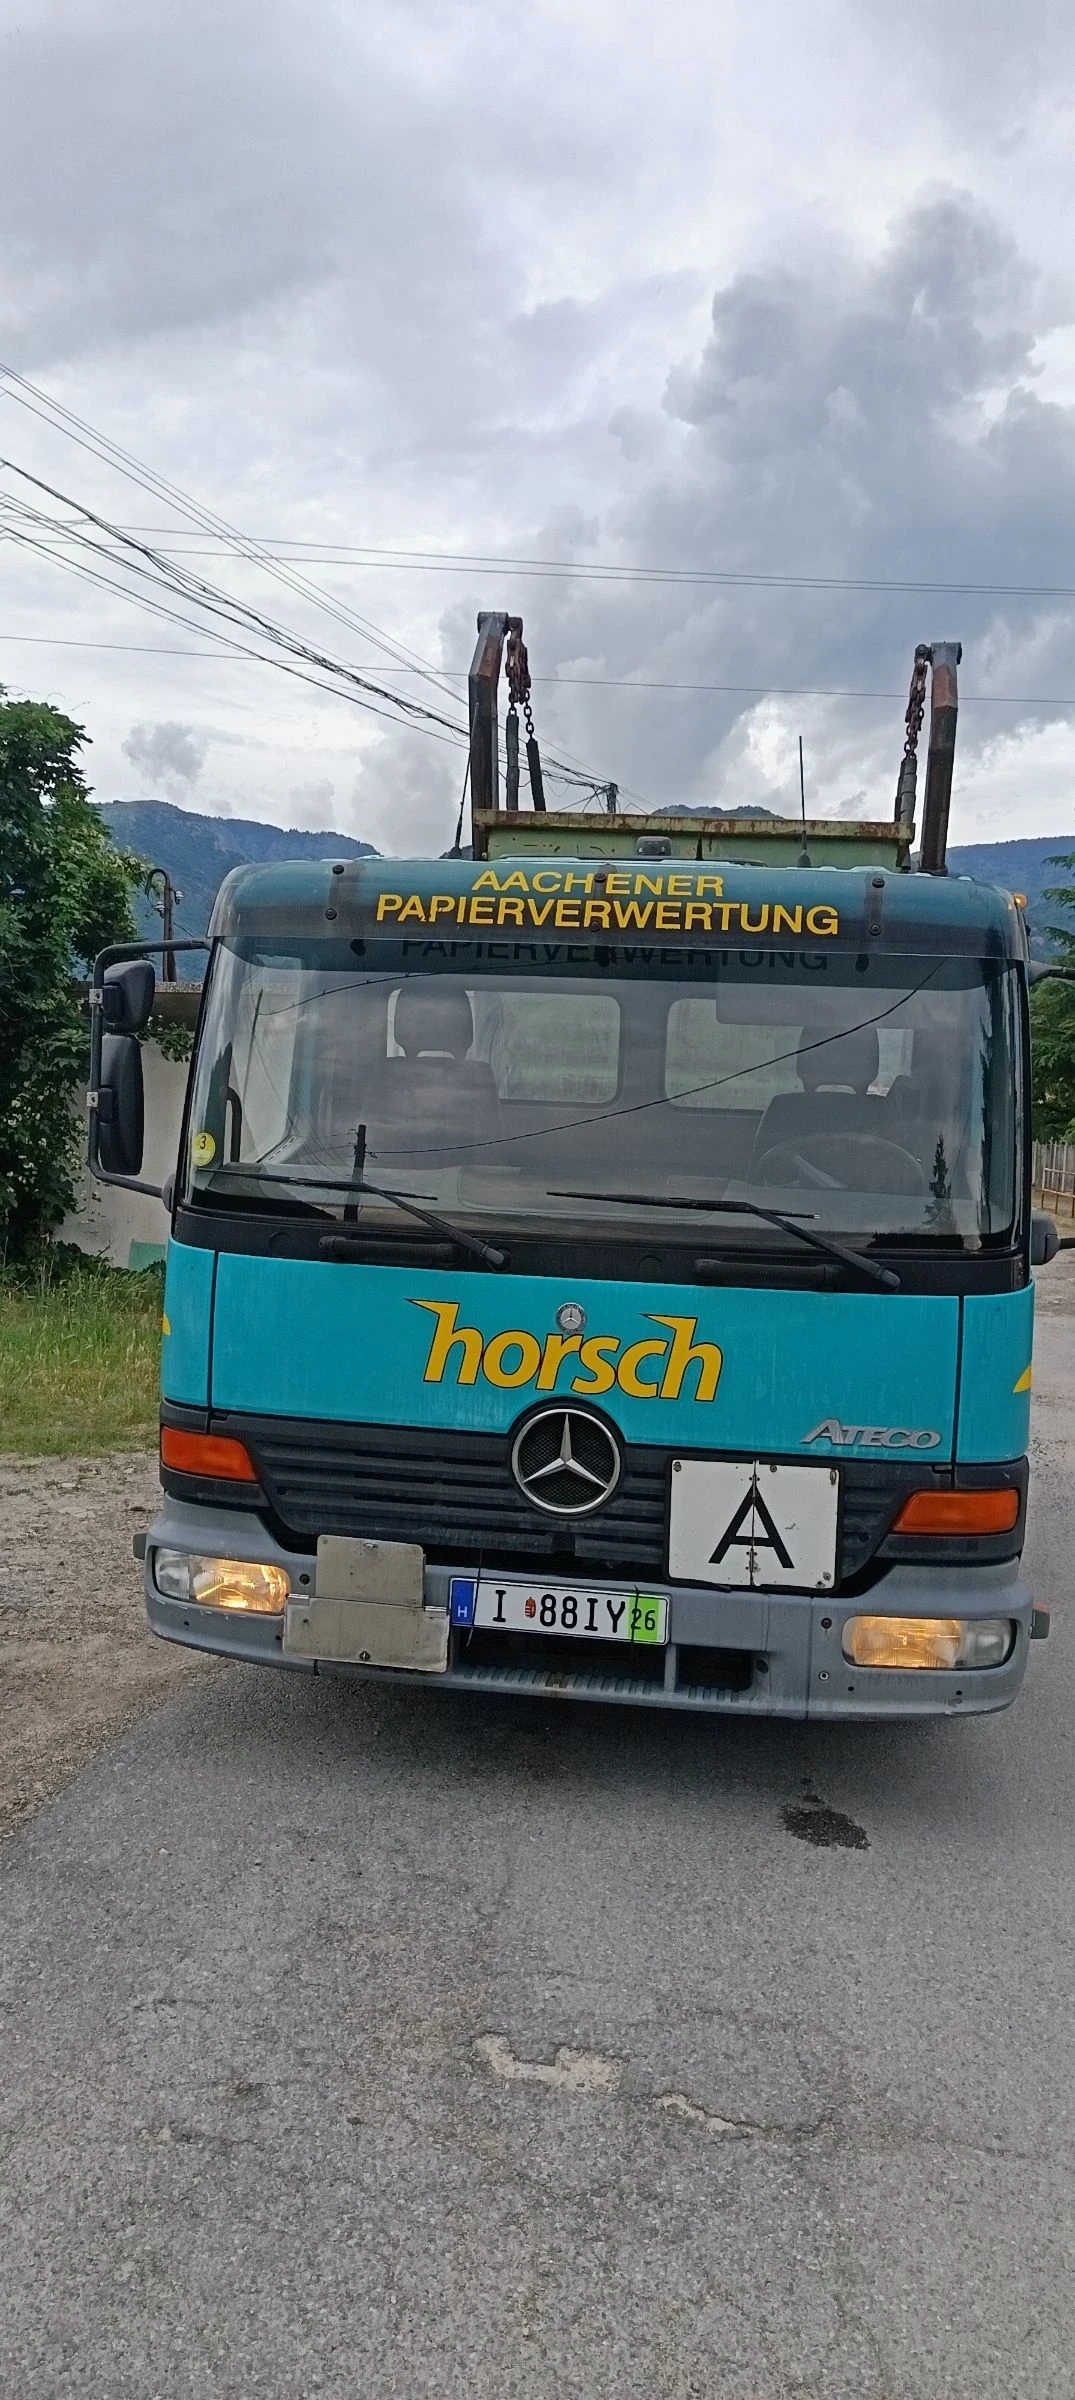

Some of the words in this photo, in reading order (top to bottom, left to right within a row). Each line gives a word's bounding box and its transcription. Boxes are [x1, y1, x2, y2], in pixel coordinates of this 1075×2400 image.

[472, 870, 724, 897] AACHENER
[376, 894, 839, 935] PAPIERVERWERTUNG
[200, 1135, 207, 1149] 3
[405, 1299, 723, 1402] horsch
[801, 1419, 942, 1449] ATECO
[708, 1480, 794, 1568] A
[457, 1605, 468, 1618] H
[630, 1608, 656, 1631] 26
